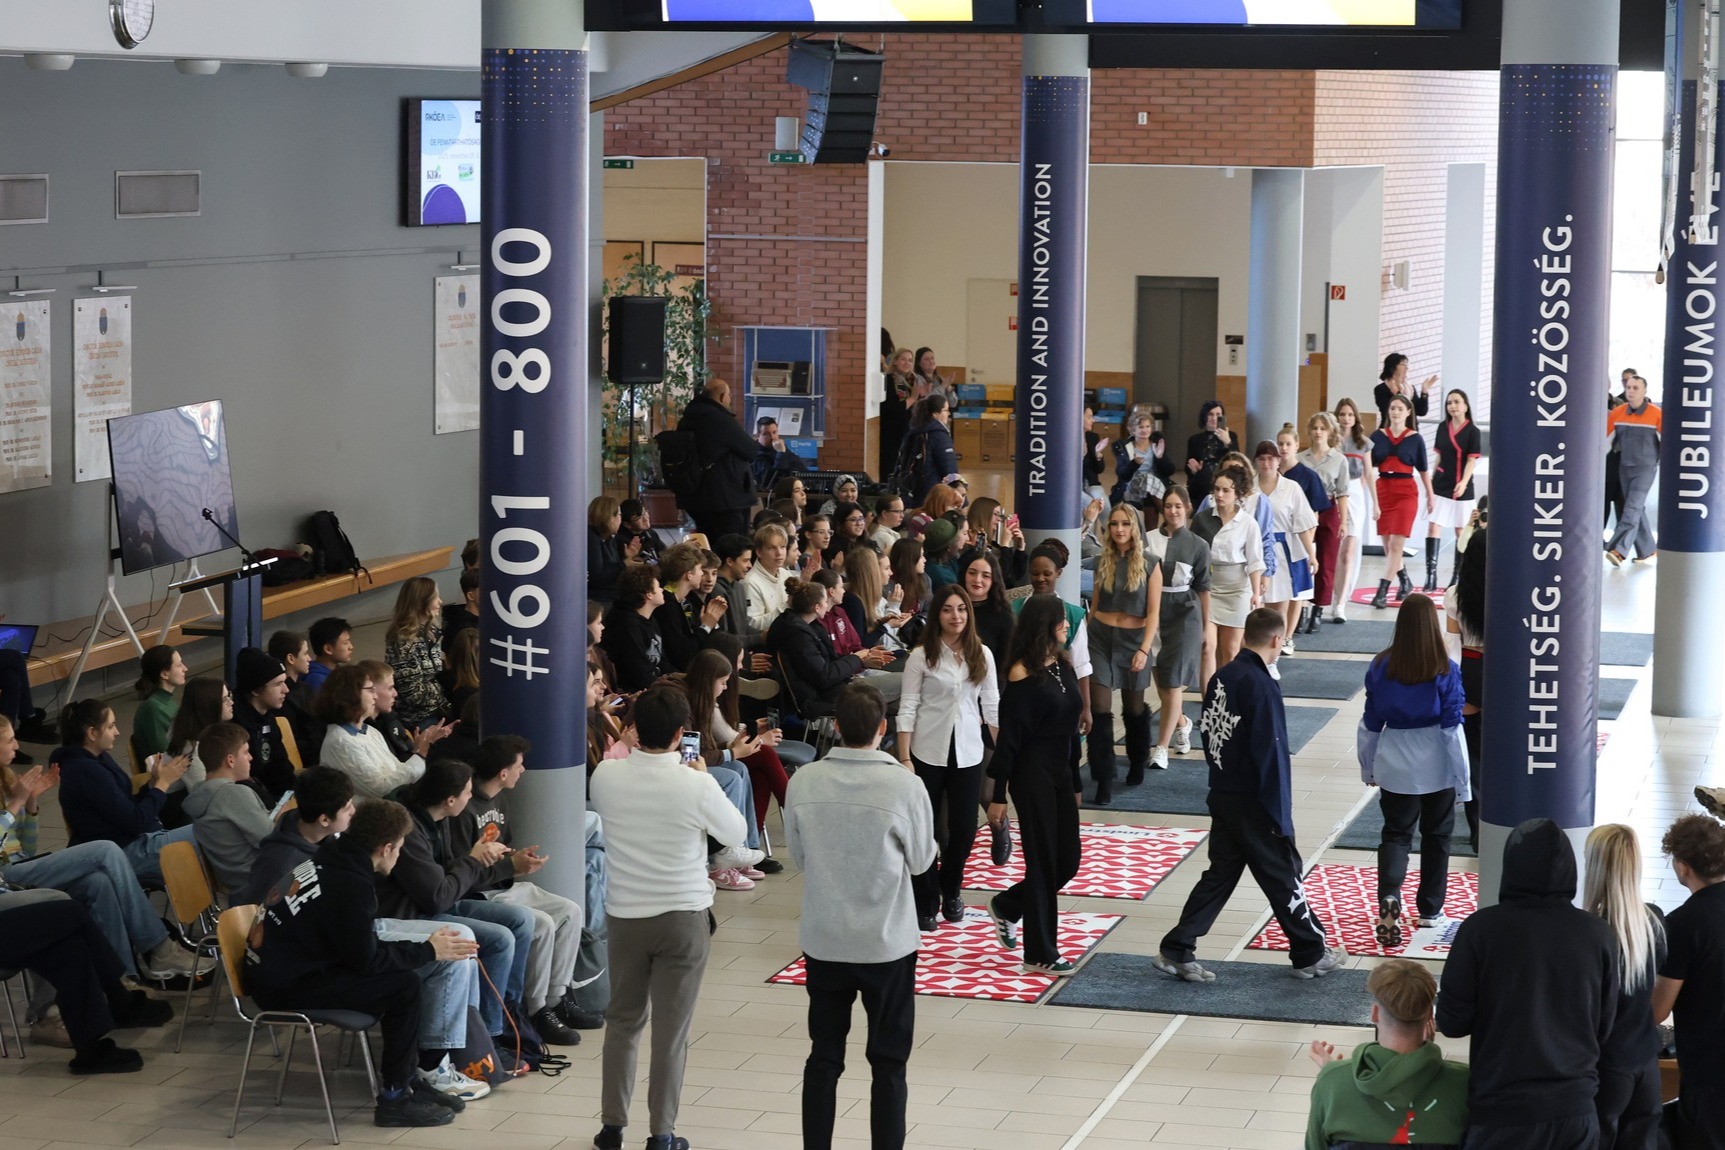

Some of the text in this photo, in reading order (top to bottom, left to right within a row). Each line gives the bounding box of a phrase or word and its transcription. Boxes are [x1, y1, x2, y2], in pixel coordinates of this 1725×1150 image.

[491, 227, 552, 394] 800
[1030, 163, 1052, 497] TRADITION AND INNOVATION
[1679, 260, 1717, 519] JUBILEUMOK
[490, 495, 551, 681] #601
[1523, 214, 1573, 775] TEHETSÉG. SIKER. KÖZÖSSÉG.
